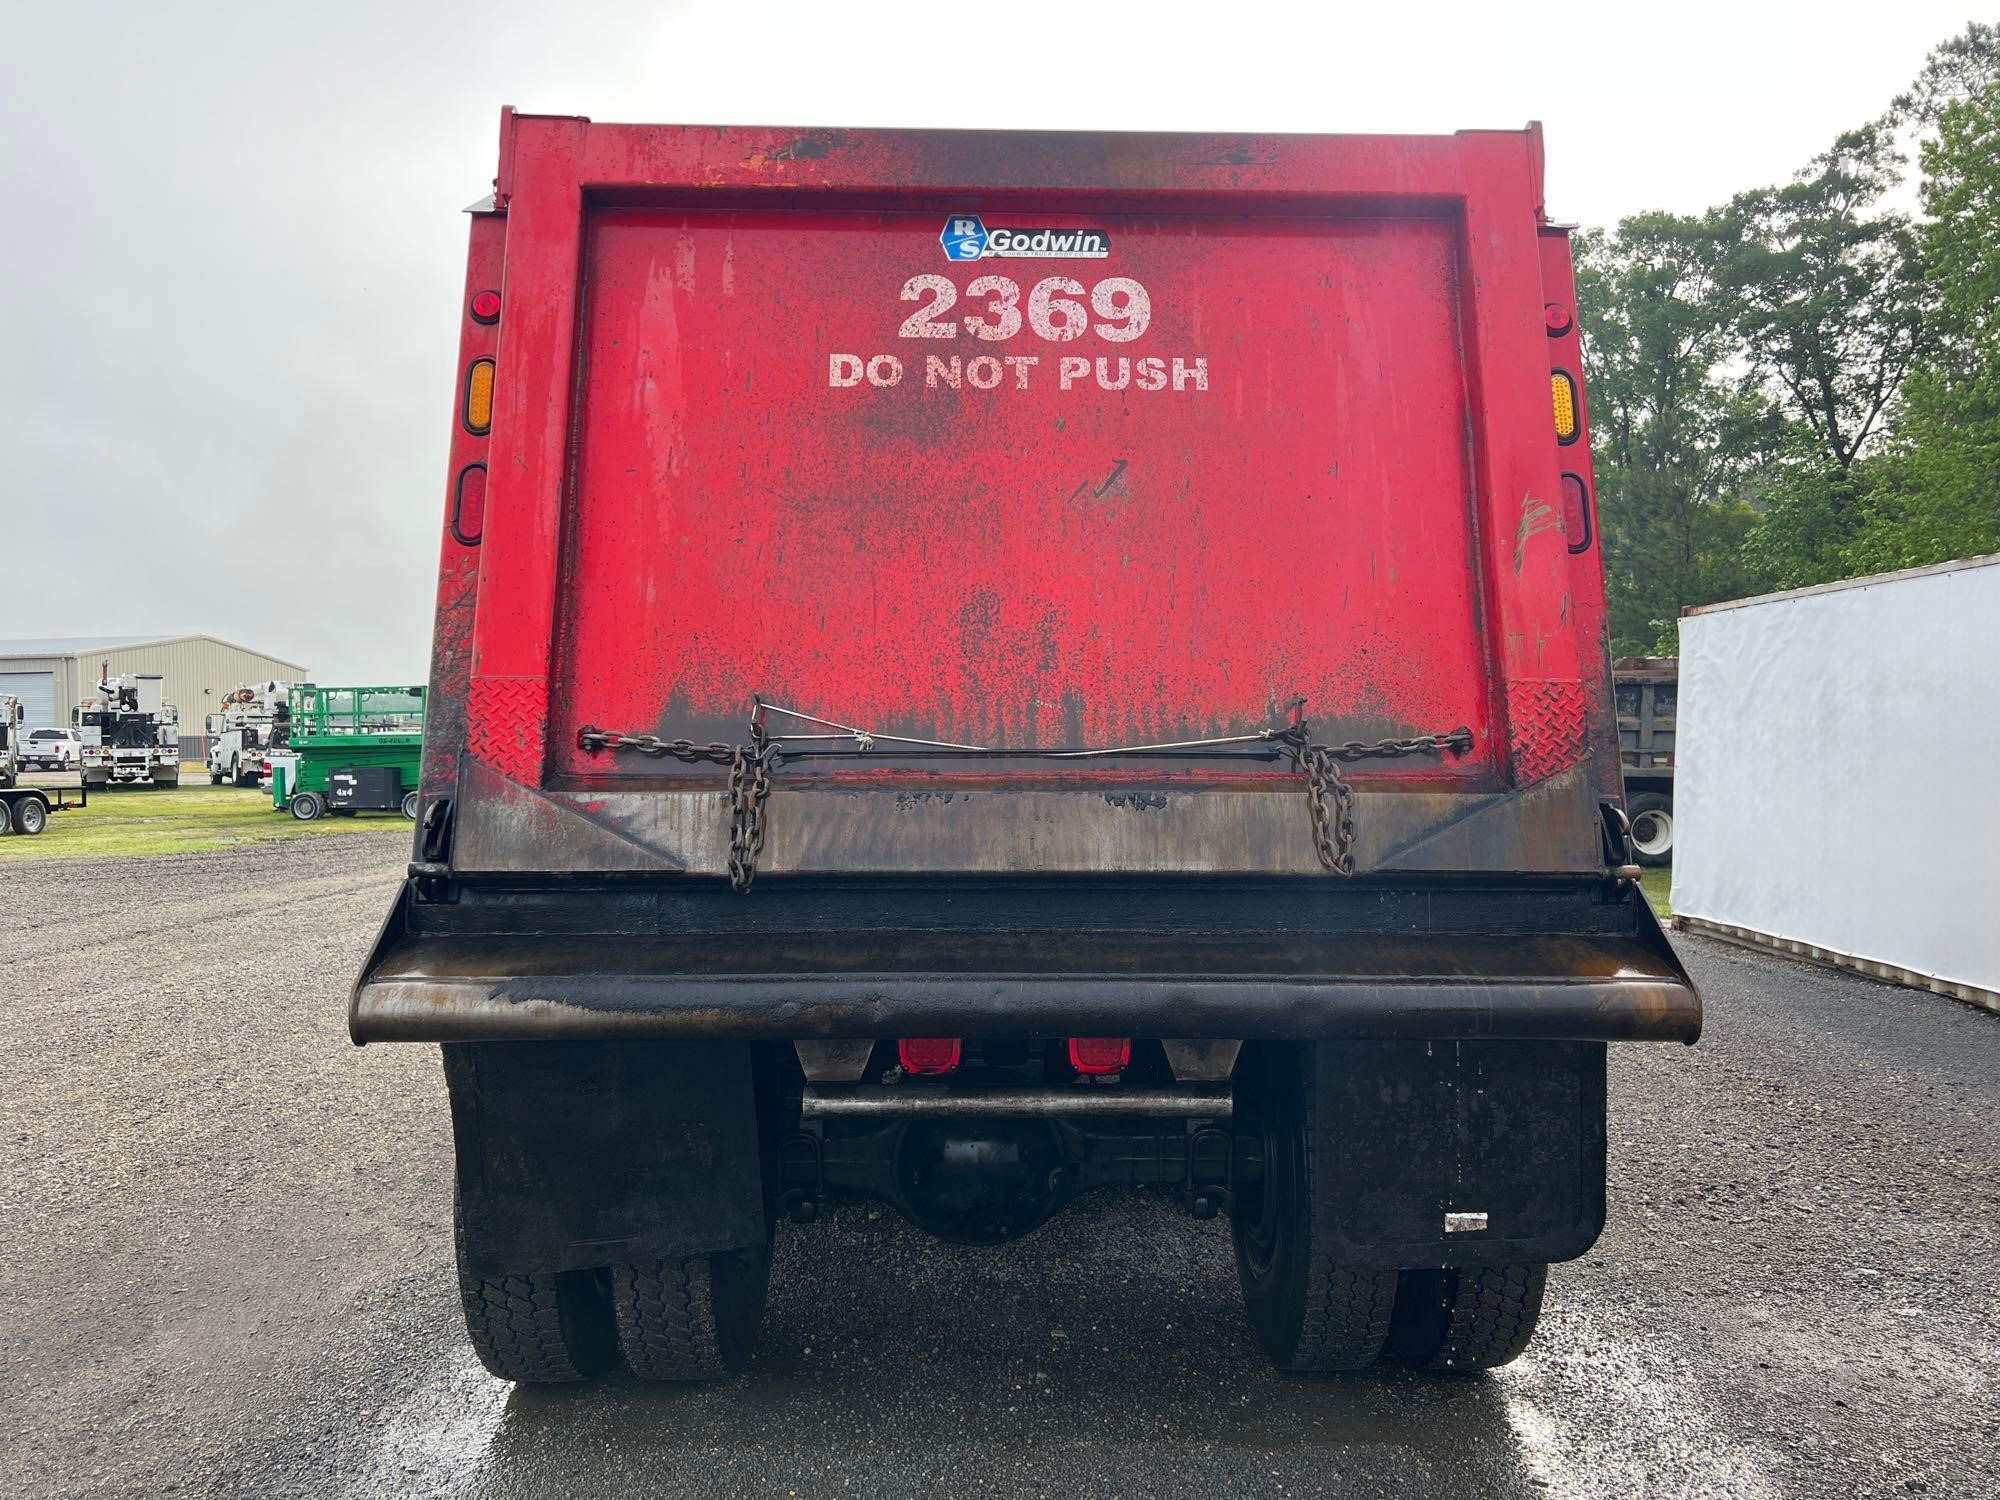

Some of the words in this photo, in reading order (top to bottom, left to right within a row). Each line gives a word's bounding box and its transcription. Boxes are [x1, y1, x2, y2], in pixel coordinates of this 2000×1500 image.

[989, 229, 1100, 252] Godwin
[899, 273, 1151, 343] 2369
[829, 353, 902, 388] DO
[927, 355, 1039, 390] NOT
[1060, 356, 1208, 391] PUSH
[336, 788, 353, 797] 4x4
